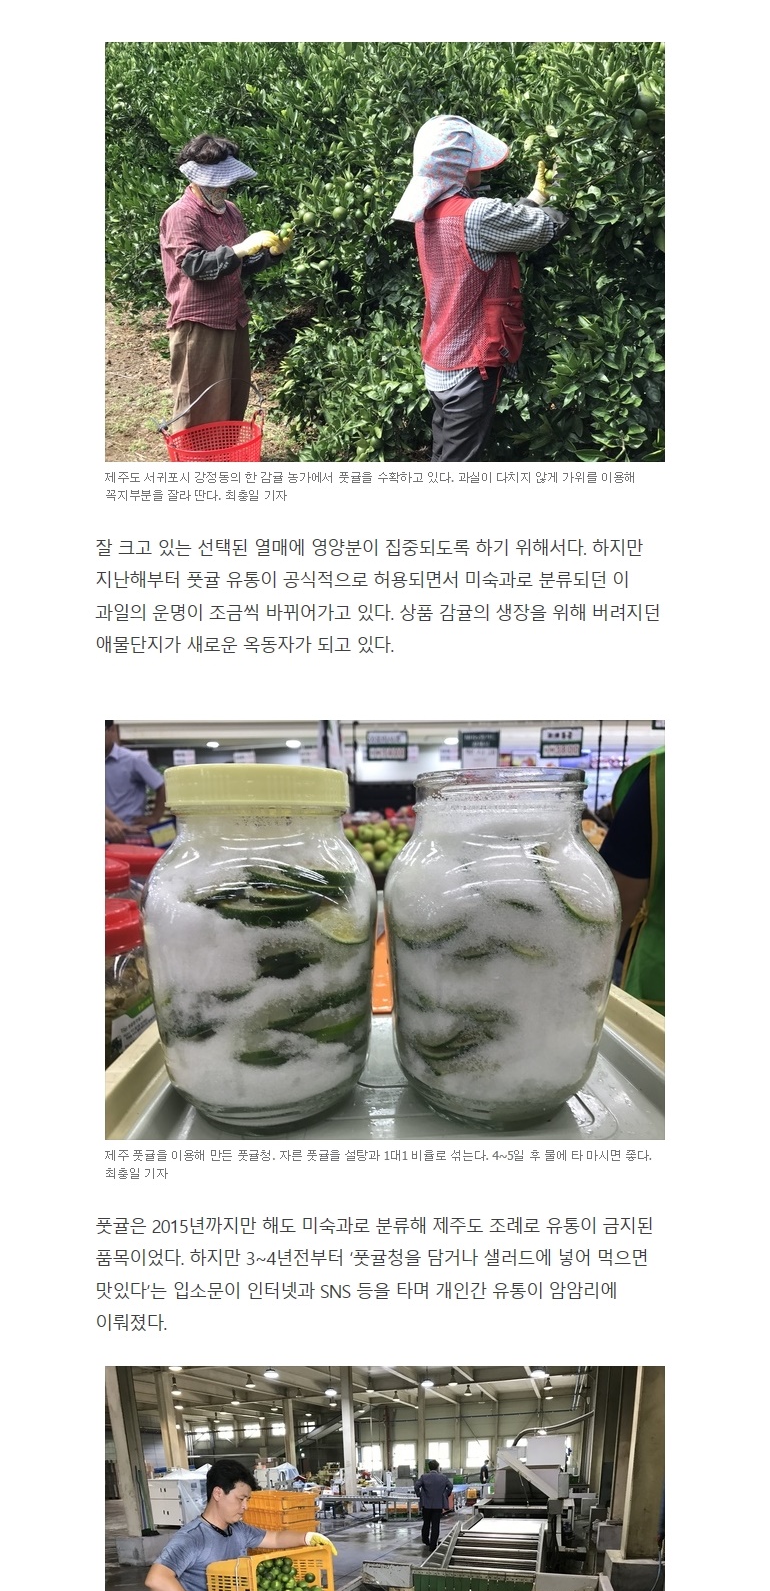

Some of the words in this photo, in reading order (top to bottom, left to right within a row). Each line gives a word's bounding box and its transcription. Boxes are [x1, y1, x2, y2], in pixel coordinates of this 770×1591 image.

[96, 635, 182, 654] 애물단지가
[187, 635, 238, 654] 새로운
[243, 635, 313, 654] 옥동자가
[317, 635, 352, 654] 되고
[357, 635, 394, 654] 있다.
[95, 1217, 147, 1235] 풋귤은
[152, 1216, 257, 1235] 2015년까지만
[262, 1216, 297, 1235] 해도
[302, 1216, 371, 1235] 미숙과로
[375, 1216, 426, 1235] 분류해
[432, 1216, 484, 1235] 제주도
[489, 1216, 541, 1235] 조례로
[545, 1216, 596, 1235] 유통이
[602, 1216, 653, 1235] 금지된
